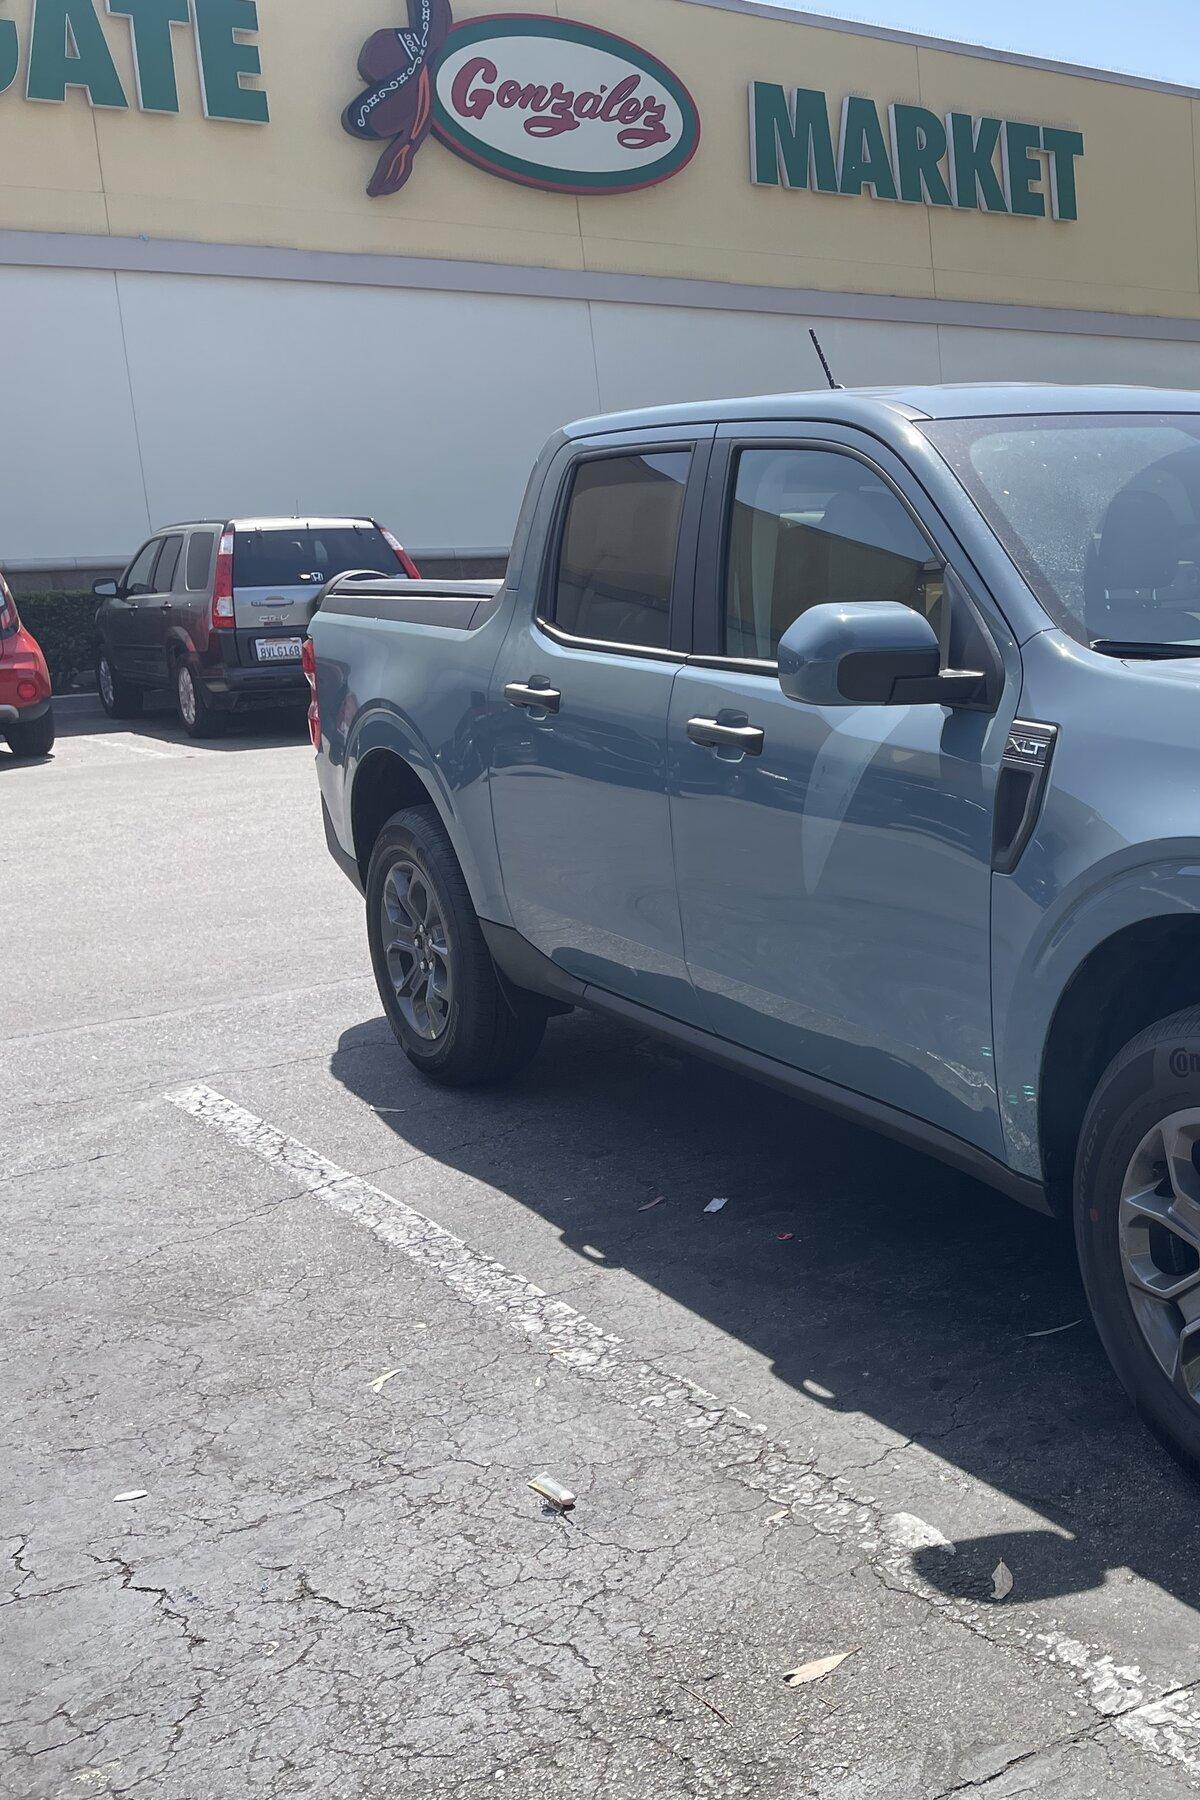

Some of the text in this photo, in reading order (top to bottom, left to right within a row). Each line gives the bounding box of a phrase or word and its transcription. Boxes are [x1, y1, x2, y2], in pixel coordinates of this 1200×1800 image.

[0, 0, 1085, 222] ATE González MARKET
[1004, 737, 1048, 756] XLT
